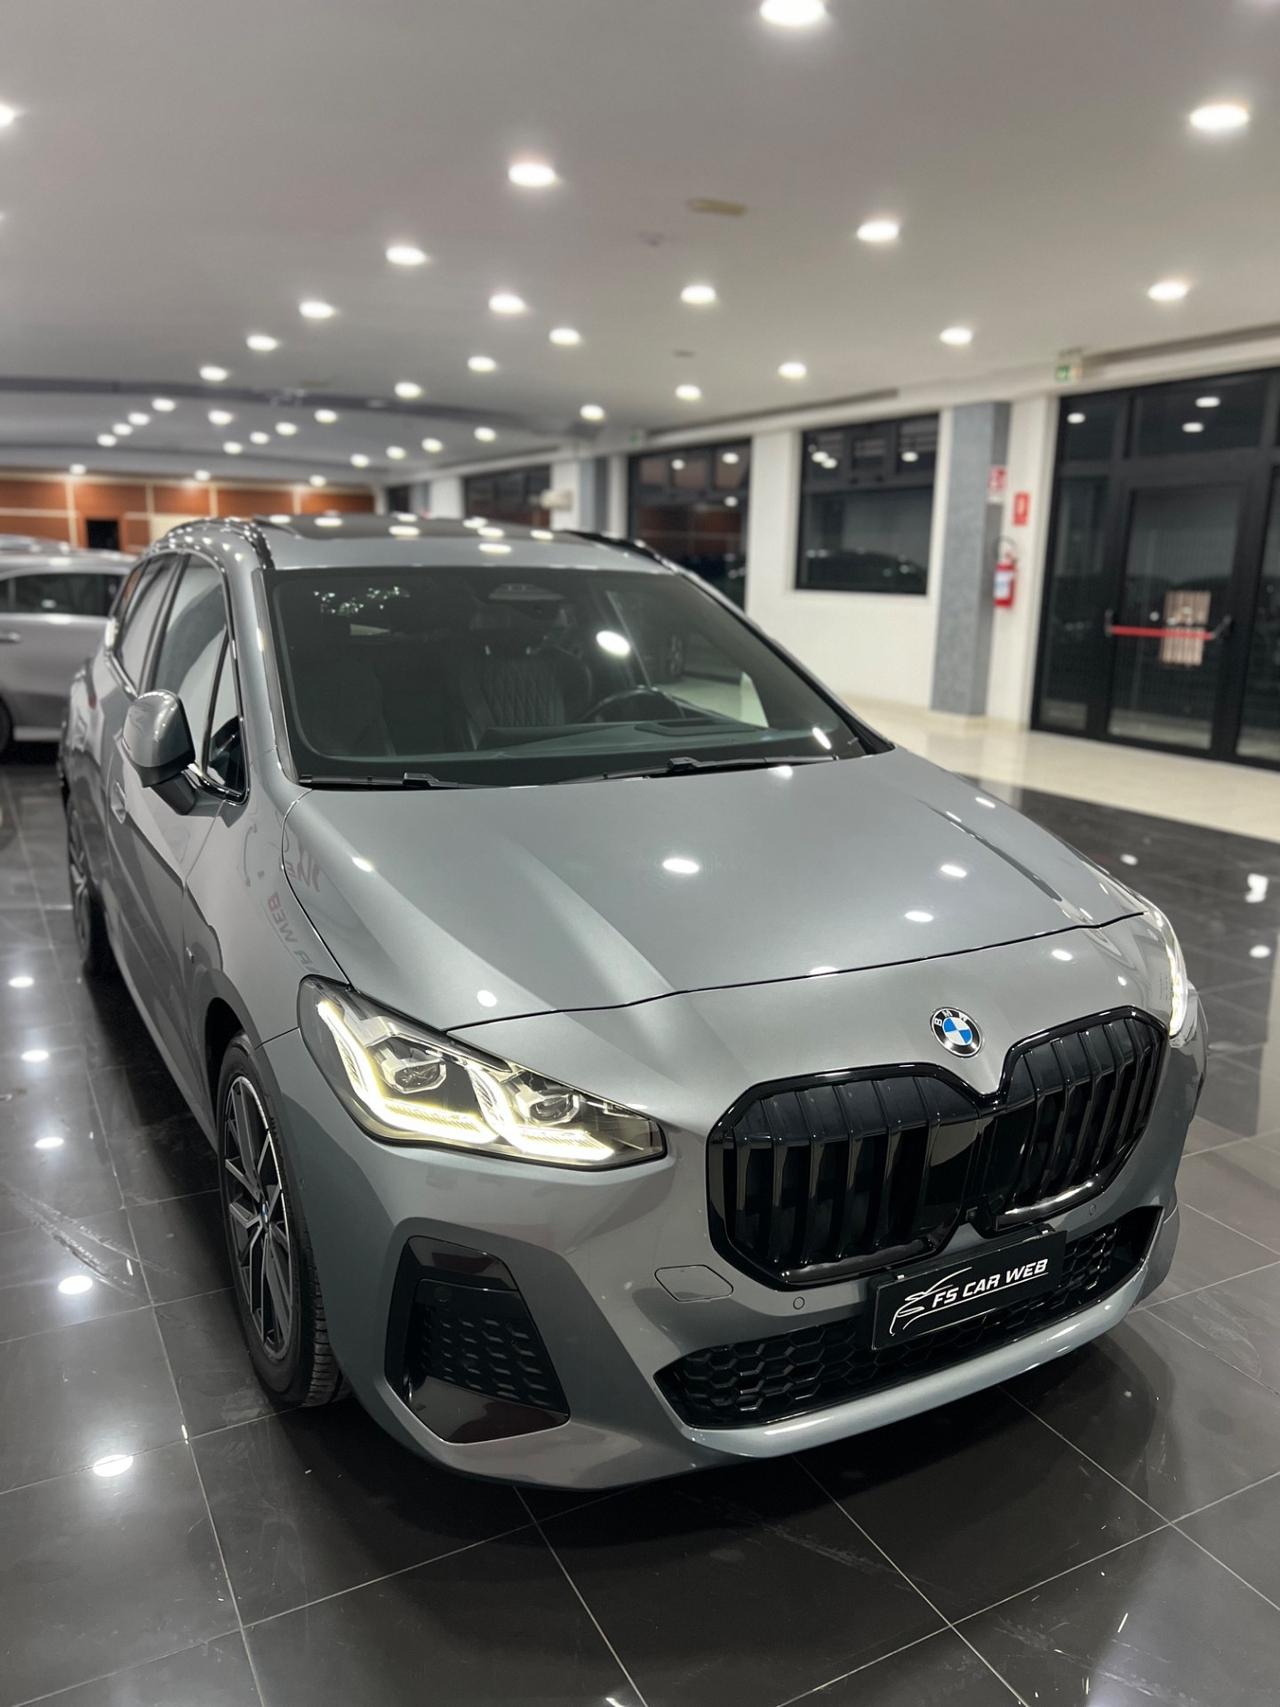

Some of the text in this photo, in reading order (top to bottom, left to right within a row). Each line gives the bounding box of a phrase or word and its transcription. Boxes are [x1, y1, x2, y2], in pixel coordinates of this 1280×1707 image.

[934, 1009, 968, 1027] BMW
[932, 1258, 1049, 1308] FS CAR WEB
